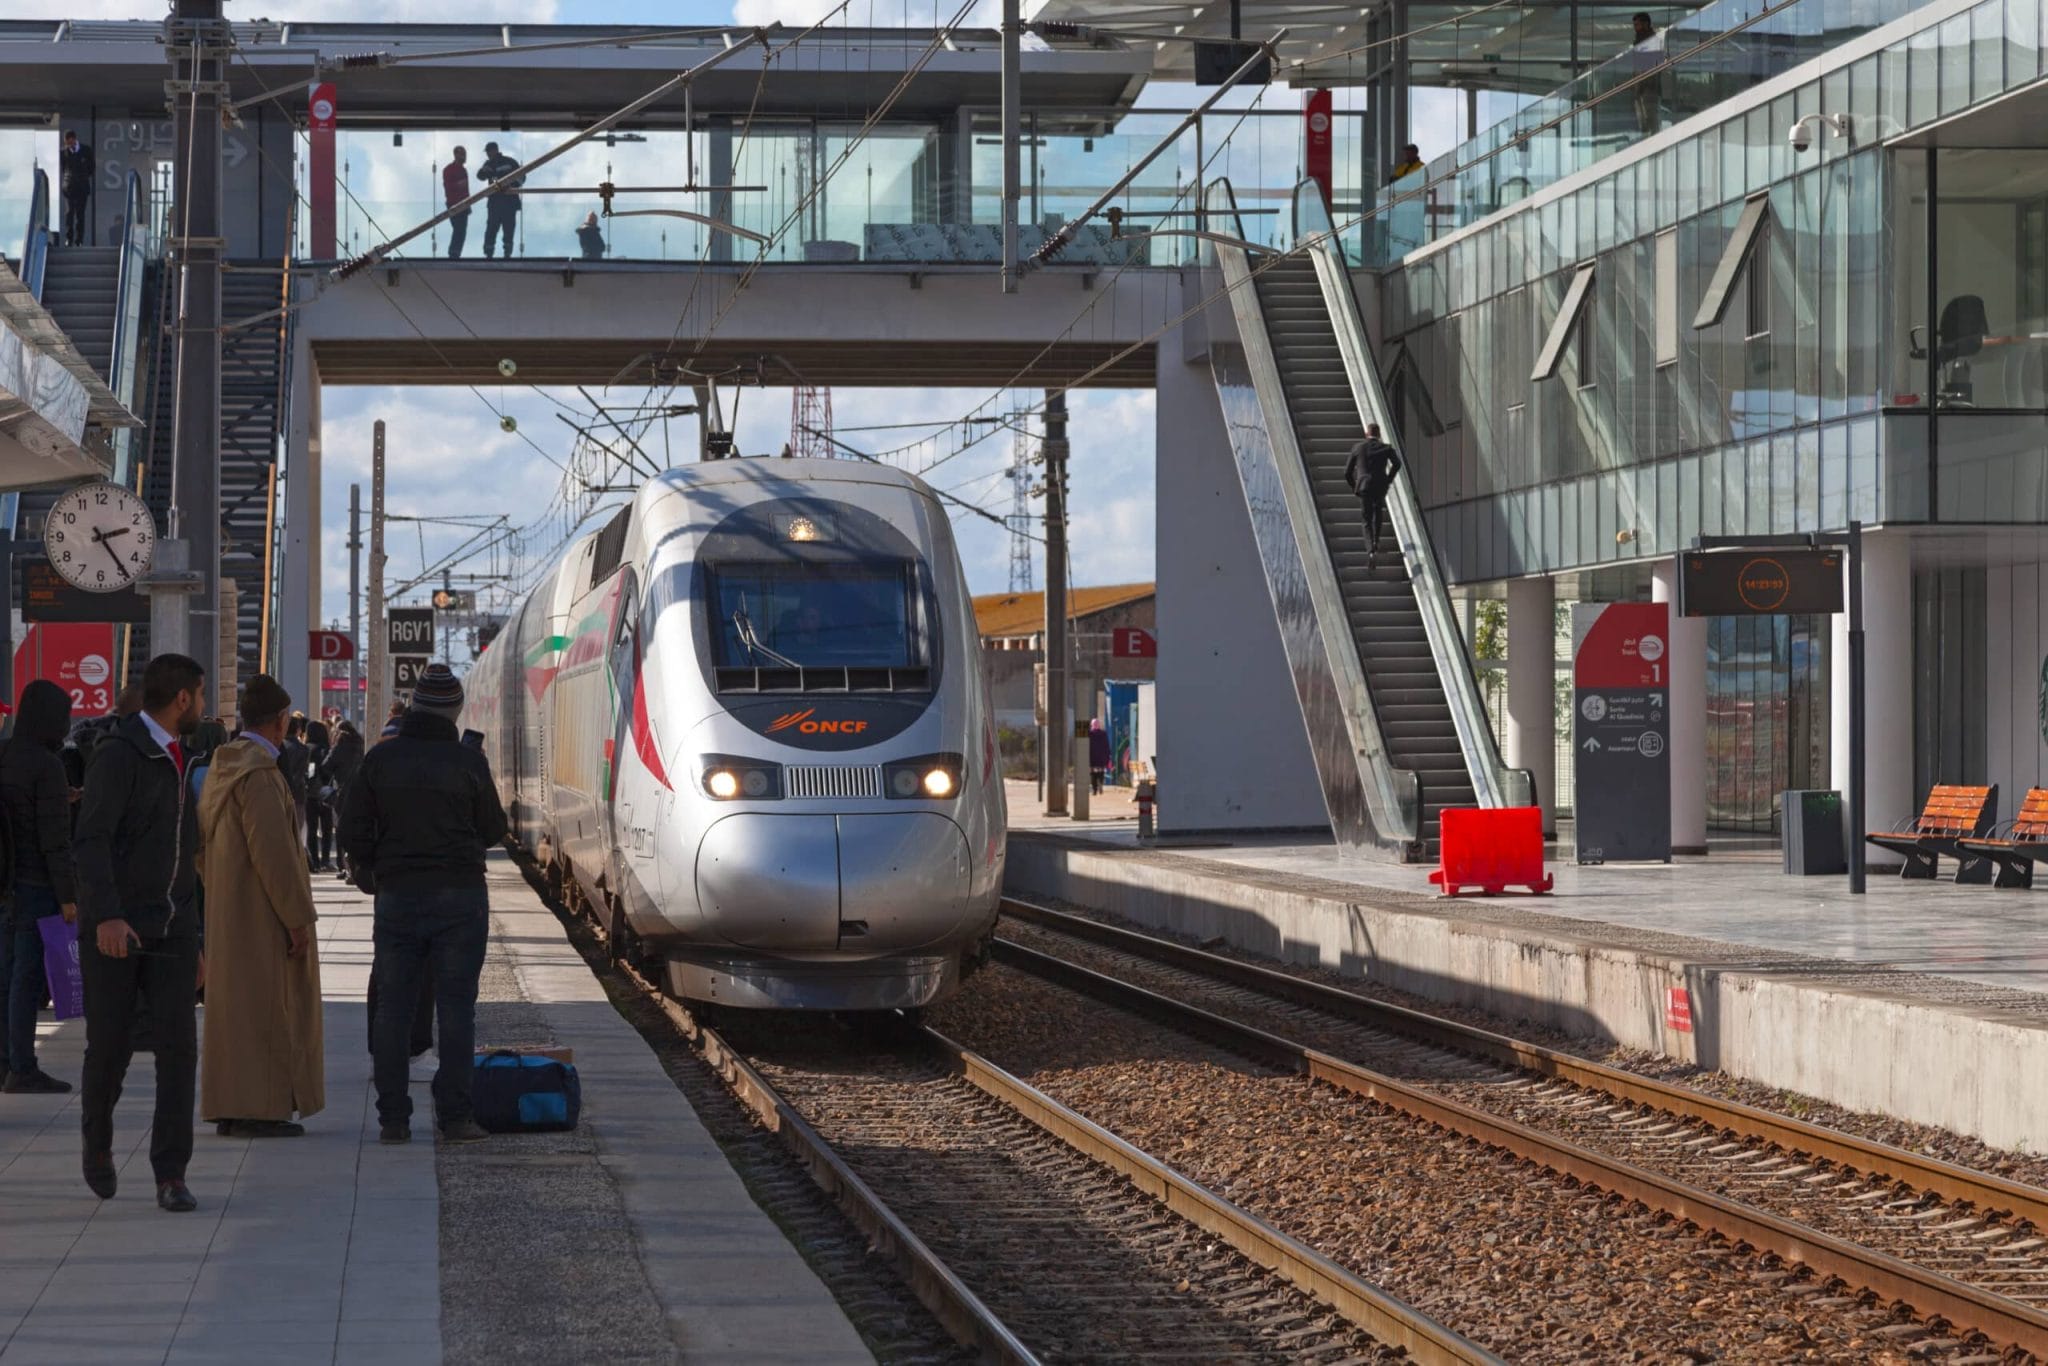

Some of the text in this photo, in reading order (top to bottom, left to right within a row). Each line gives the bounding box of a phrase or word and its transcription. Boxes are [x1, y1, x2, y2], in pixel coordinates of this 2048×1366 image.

[78, 499, 87, 511] 11
[95, 493, 108, 505] 12
[118, 499, 124, 511] 1
[62, 513, 76, 524] 10
[132, 513, 140, 525] 2
[56, 531, 65, 543] 9
[137, 532, 146, 544] 3
[62, 551, 71, 562] 8
[130, 551, 139, 563] 4
[78, 564, 87, 575] 7
[96, 570, 105, 582] 6
[391, 621, 431, 642] RGV1
[321, 635, 342, 657] D
[1128, 631, 1141, 654] E
[398, 663, 409, 682] 6
[1651, 664, 1660, 683] 1
[799, 720, 868, 734] ONCF
